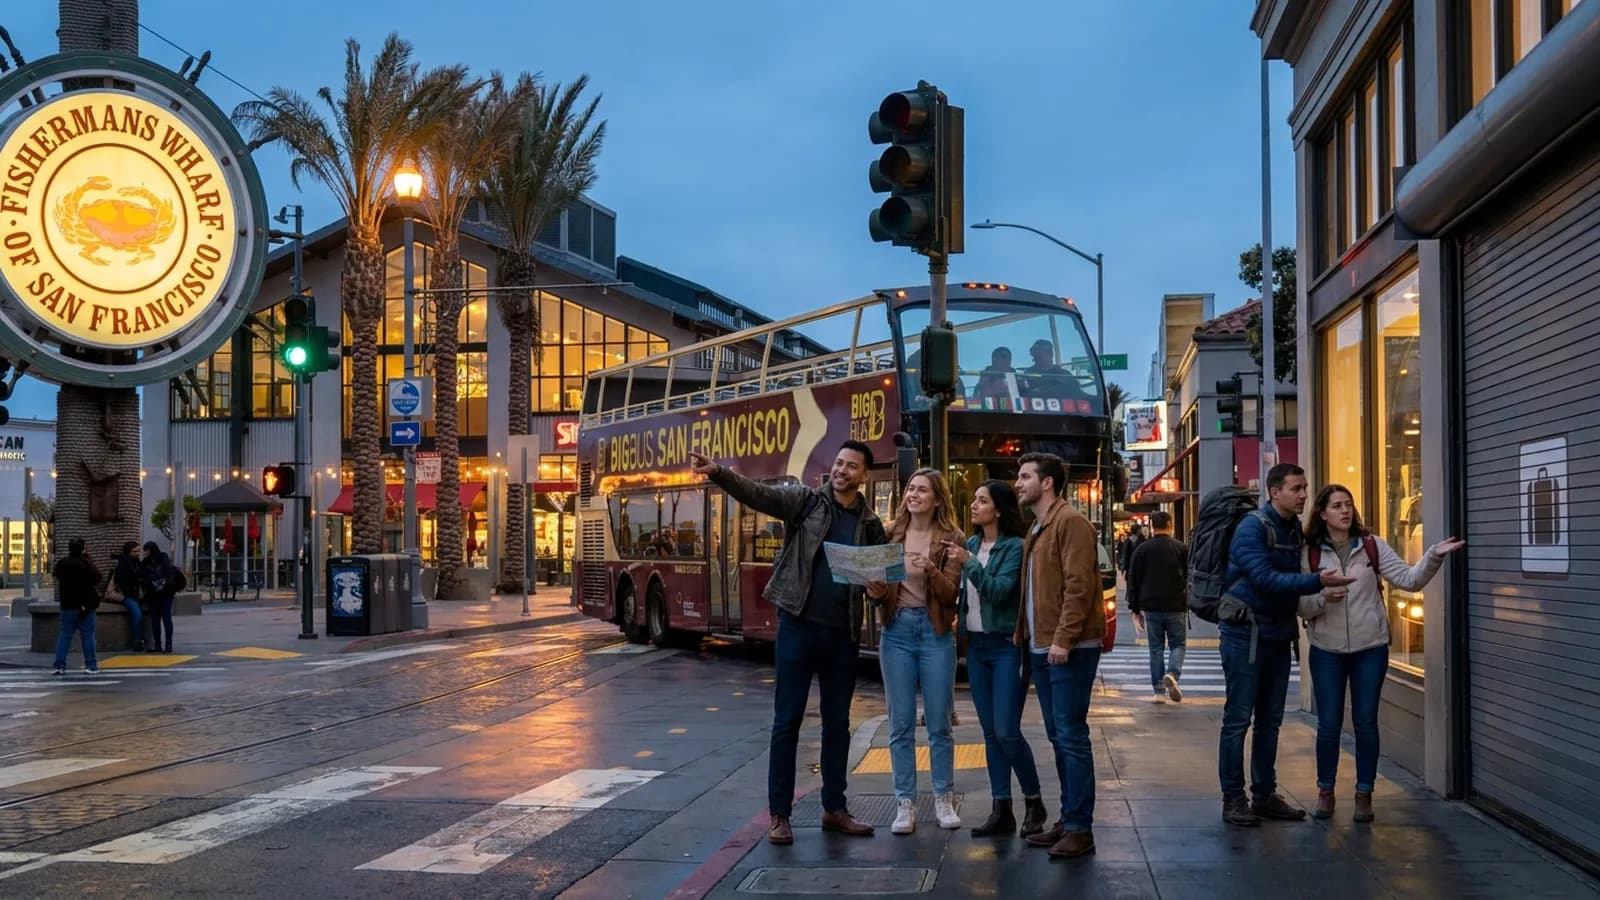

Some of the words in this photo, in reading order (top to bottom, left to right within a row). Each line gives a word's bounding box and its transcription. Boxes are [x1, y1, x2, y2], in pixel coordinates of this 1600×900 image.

[1, 104, 160, 216] FISHERMANS
[159, 125, 225, 231] WHARF
[5, 231, 41, 267] OF
[26, 271, 85, 324] SAN
[88, 243, 222, 335] FRANCISCO
[657, 424, 688, 467] SAN
[691, 407, 789, 461] FRANCISCO
[851, 392, 870, 419] BIG
